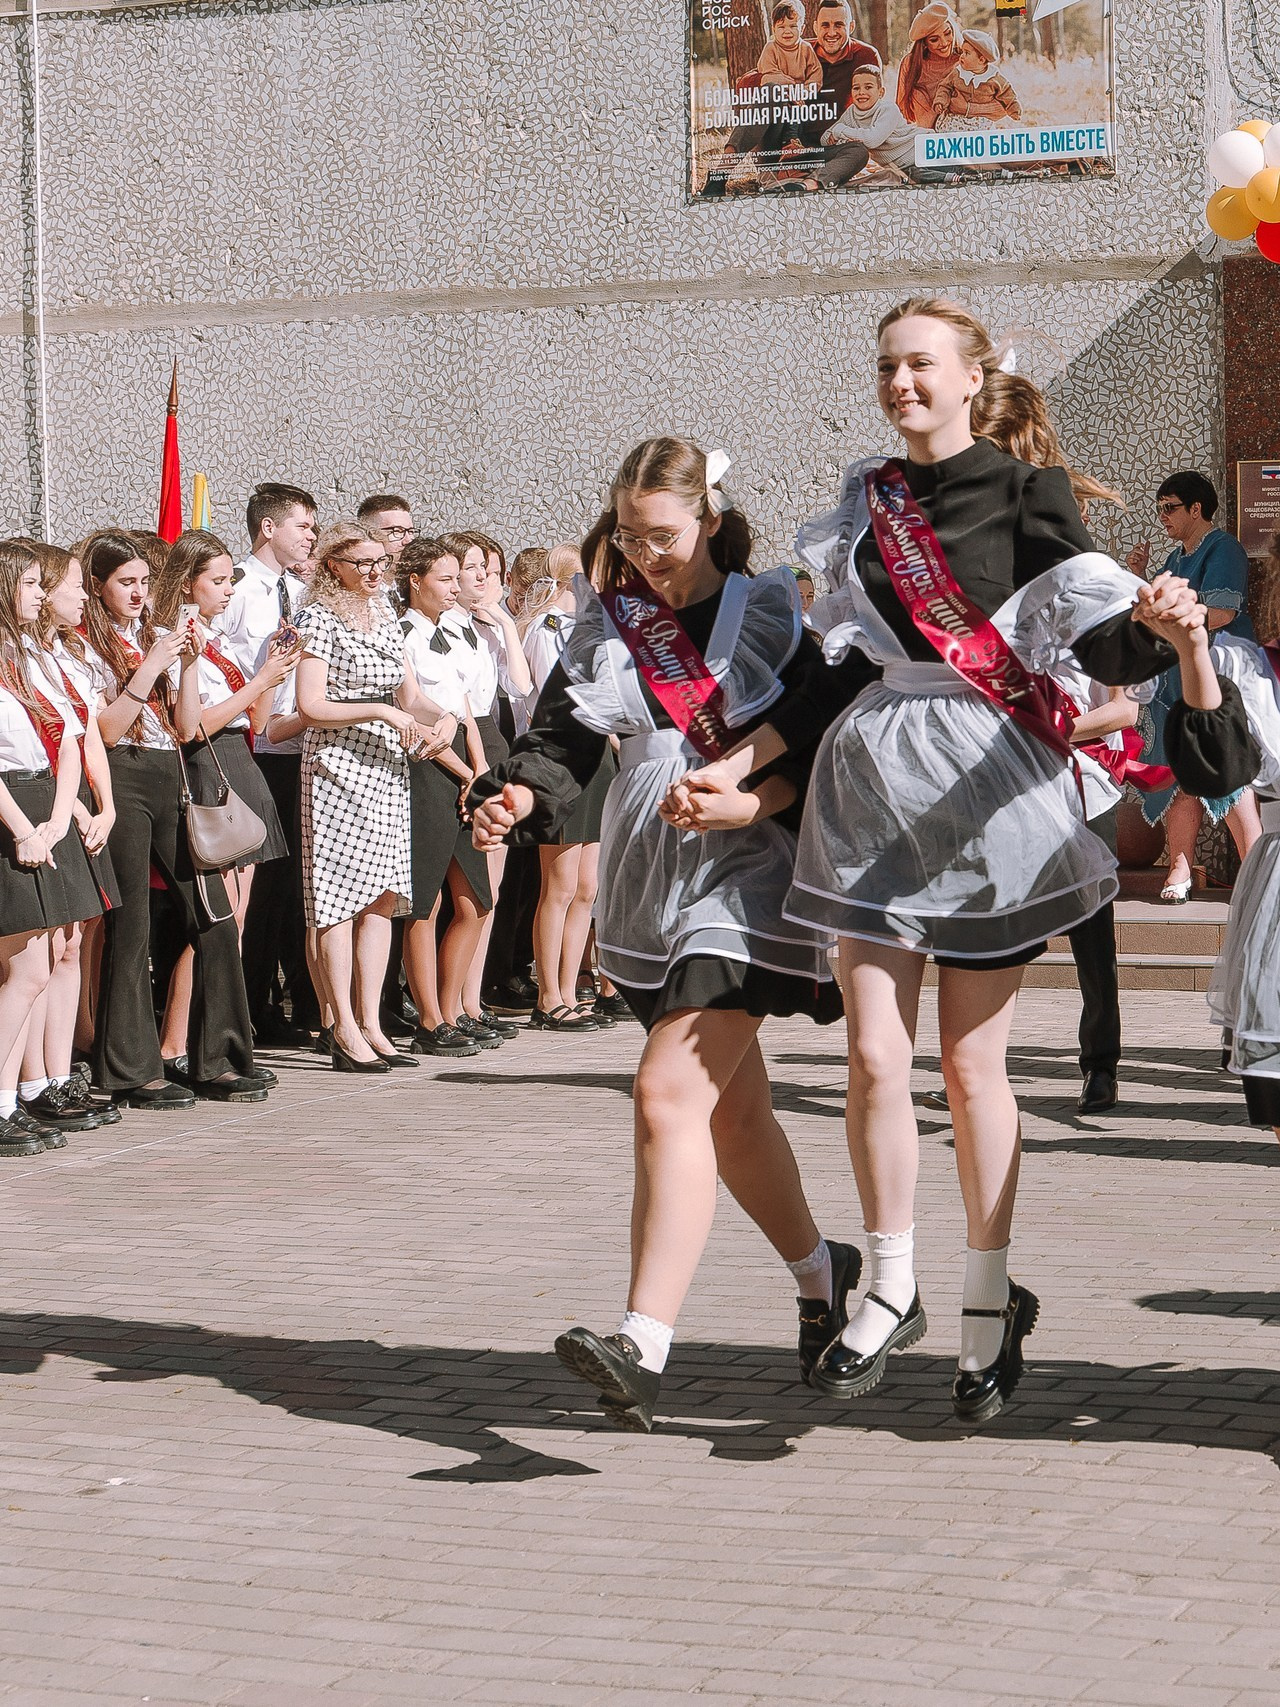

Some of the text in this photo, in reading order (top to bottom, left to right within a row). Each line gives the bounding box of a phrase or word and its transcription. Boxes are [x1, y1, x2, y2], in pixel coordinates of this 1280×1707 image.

[702, 15, 750, 30] СИЙСК
[704, 85, 770, 108] БОЛЬШАЯ
[772, 82, 818, 103] СЕМЬЯ
[705, 102, 838, 129] БОЛЬШАЯ РАДОСТЬ!
[925, 128, 1106, 160] ВАЖНО БЫТЬ ВМЕСТЕ
[882, 533, 899, 559] МАОУ
[900, 578, 917, 603] СОШ
